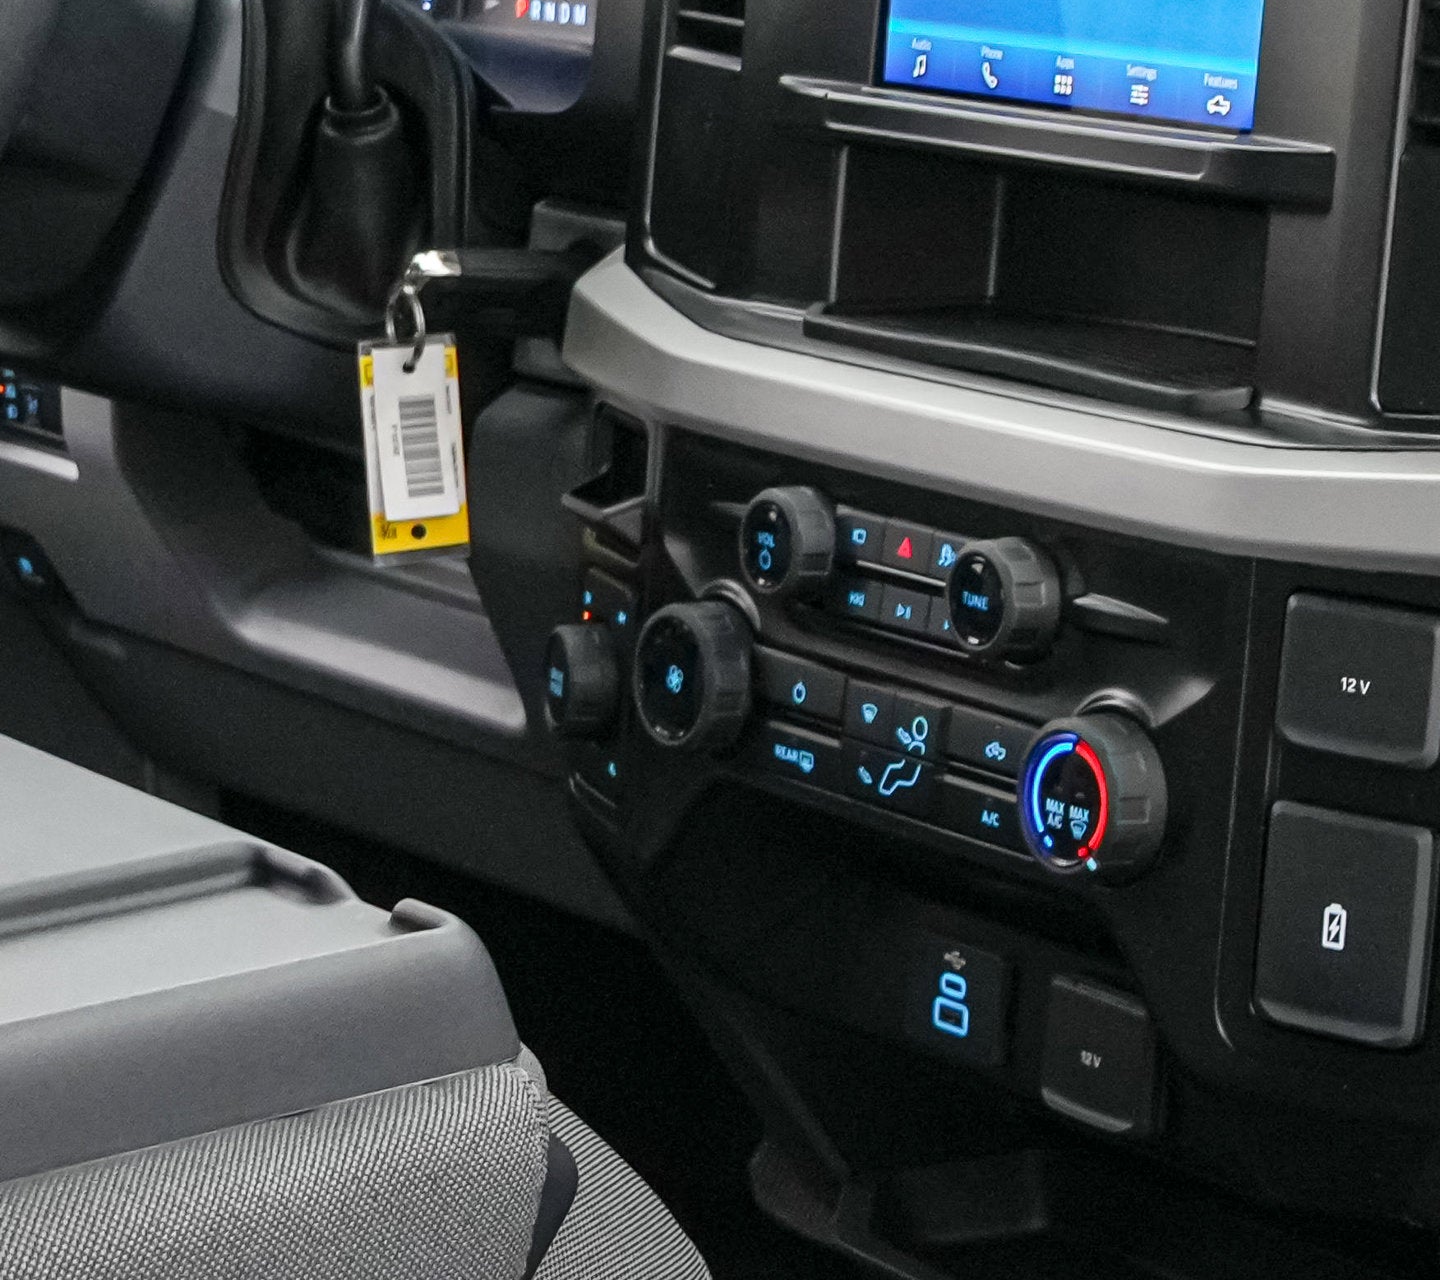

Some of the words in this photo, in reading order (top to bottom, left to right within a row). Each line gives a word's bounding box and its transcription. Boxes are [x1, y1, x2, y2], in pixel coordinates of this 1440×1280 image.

[981, 45, 1003, 61] Phone
[1204, 72, 1239, 91] Features
[962, 590, 989, 611] TUNE
[774, 742, 798, 763] REAR
[1046, 797, 1065, 816] MAX
[1069, 804, 1090, 823] MAX
[981, 809, 1000, 828] A/C
